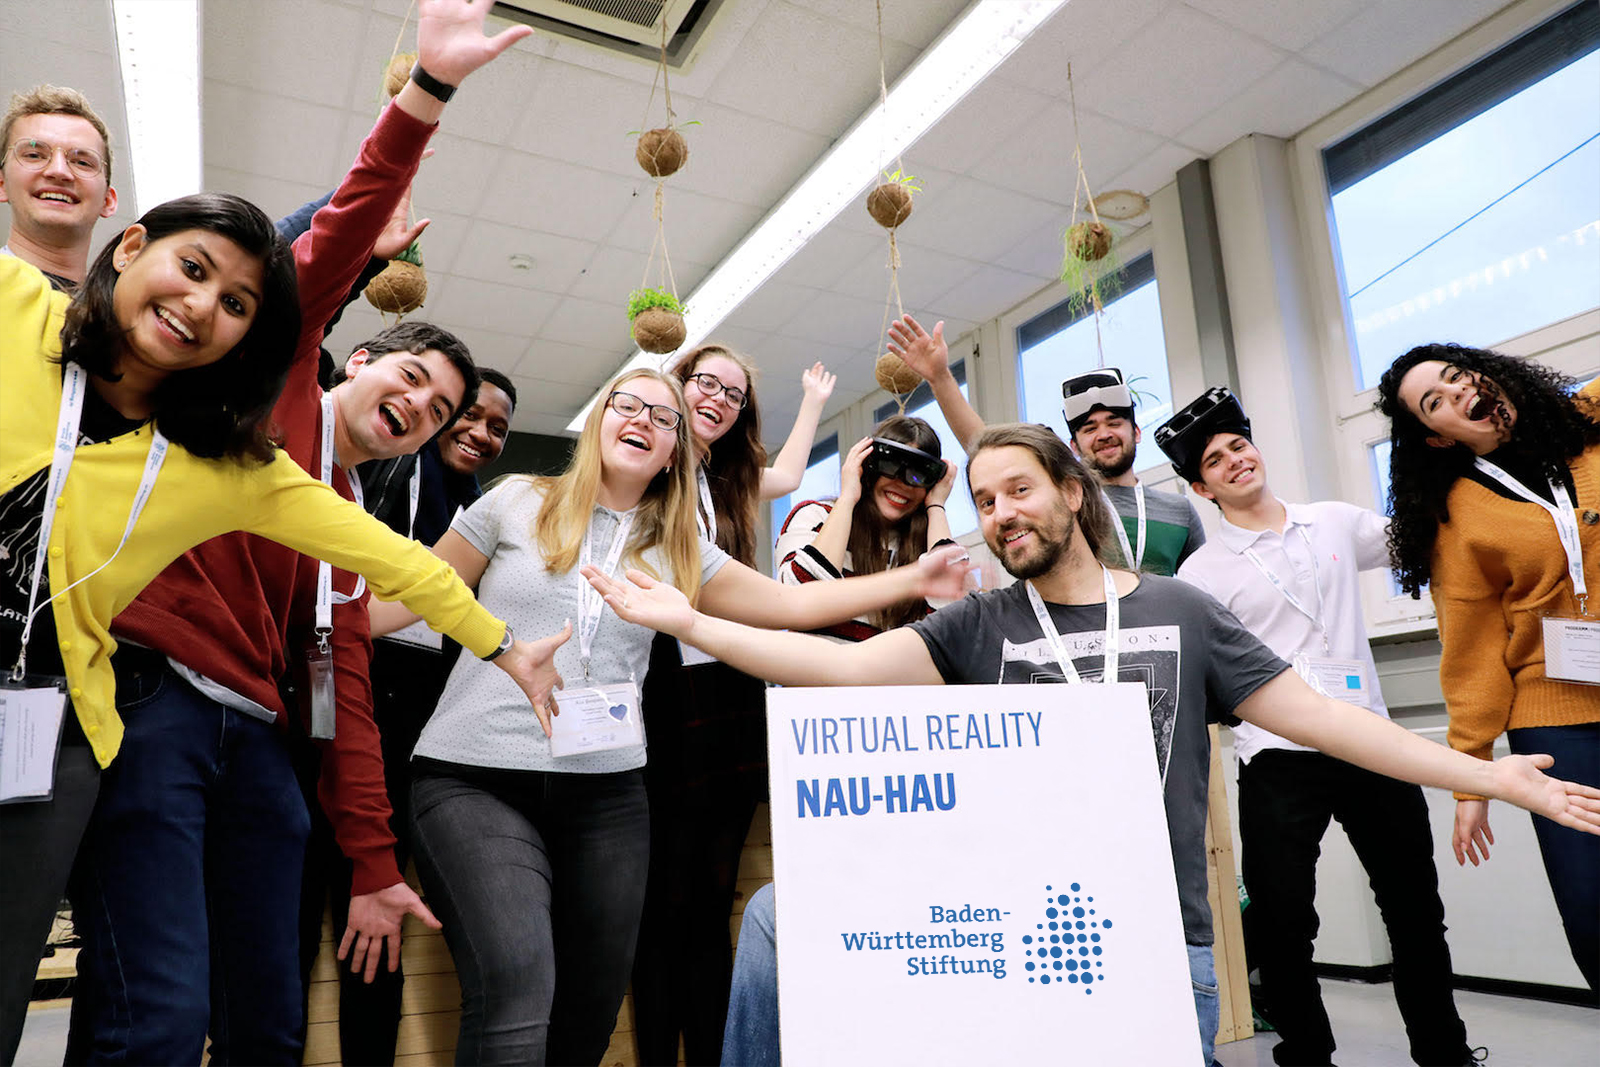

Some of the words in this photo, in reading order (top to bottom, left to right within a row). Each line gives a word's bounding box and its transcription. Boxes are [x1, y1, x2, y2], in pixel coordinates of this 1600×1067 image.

[791, 715, 919, 755] VIRTUAL
[926, 711, 1043, 751] REALITY
[796, 772, 957, 819] NAU-HAU
[929, 904, 1011, 924] Baden-
[841, 928, 1005, 952] Württemberg
[907, 955, 1007, 980] Stiftung
